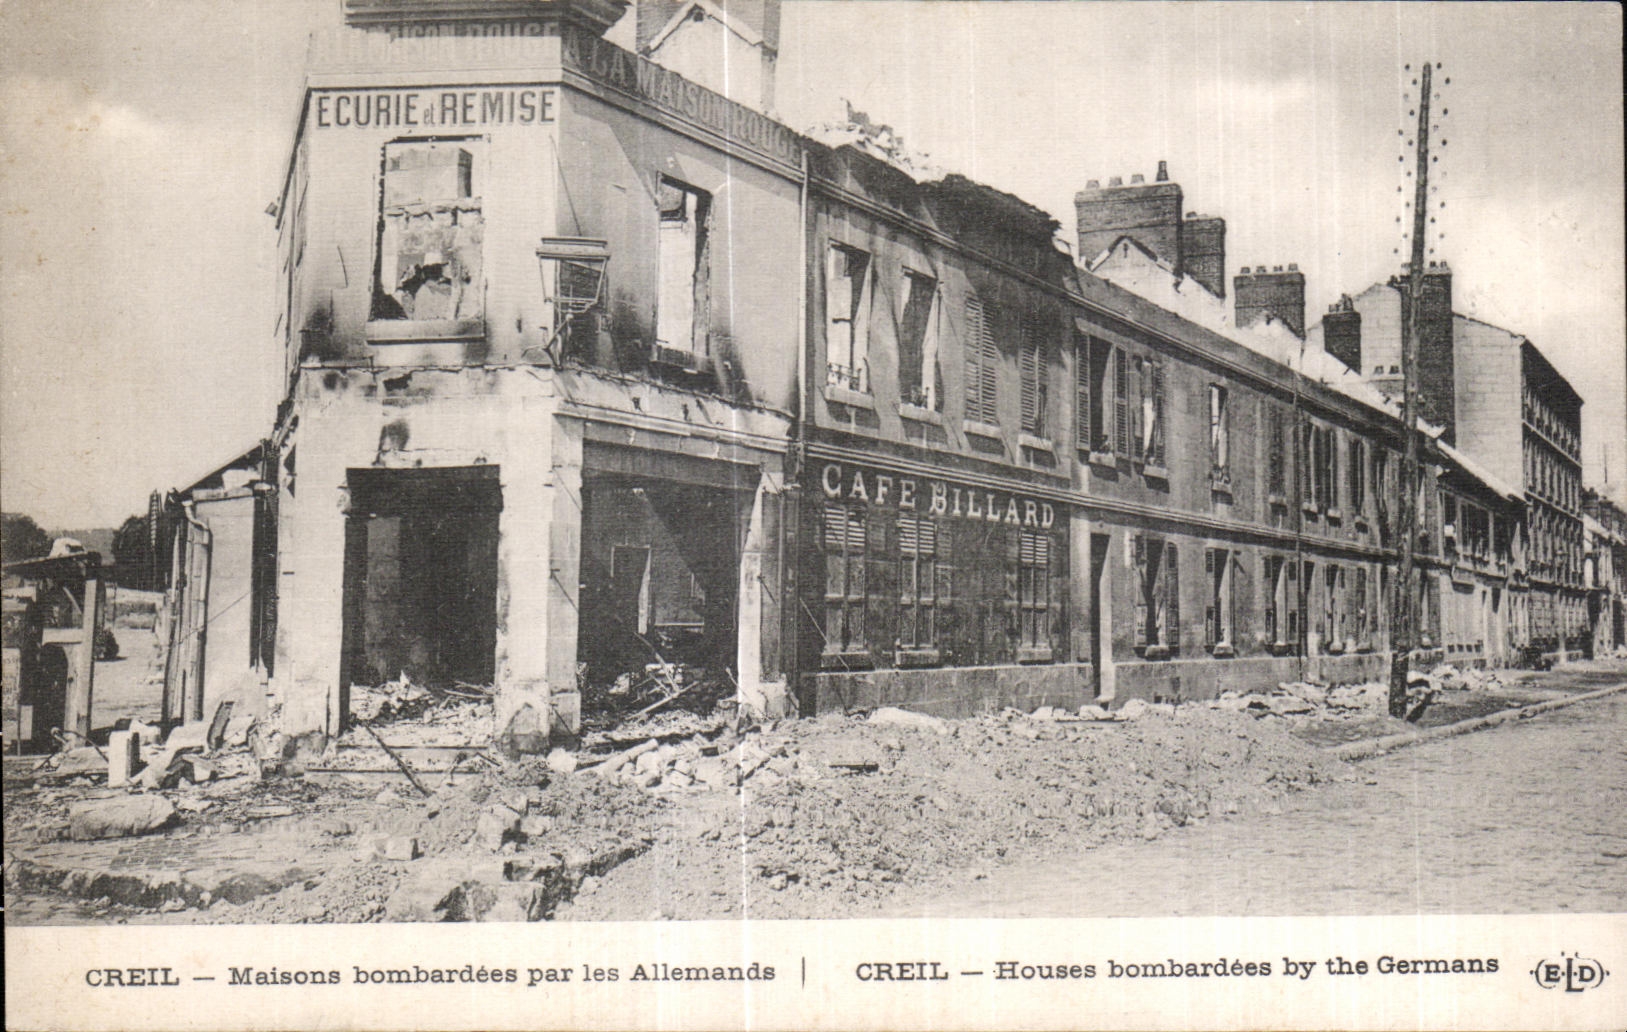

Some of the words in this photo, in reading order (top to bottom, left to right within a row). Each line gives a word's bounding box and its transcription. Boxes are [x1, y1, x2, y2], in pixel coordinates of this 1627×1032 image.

[317, 93, 420, 128] ECURIE
[423, 101, 437, 127] et
[440, 90, 556, 126] REMISE
[636, 56, 730, 132] MAISON
[822, 464, 917, 509] CAFE
[929, 481, 1055, 529] BILLARD
